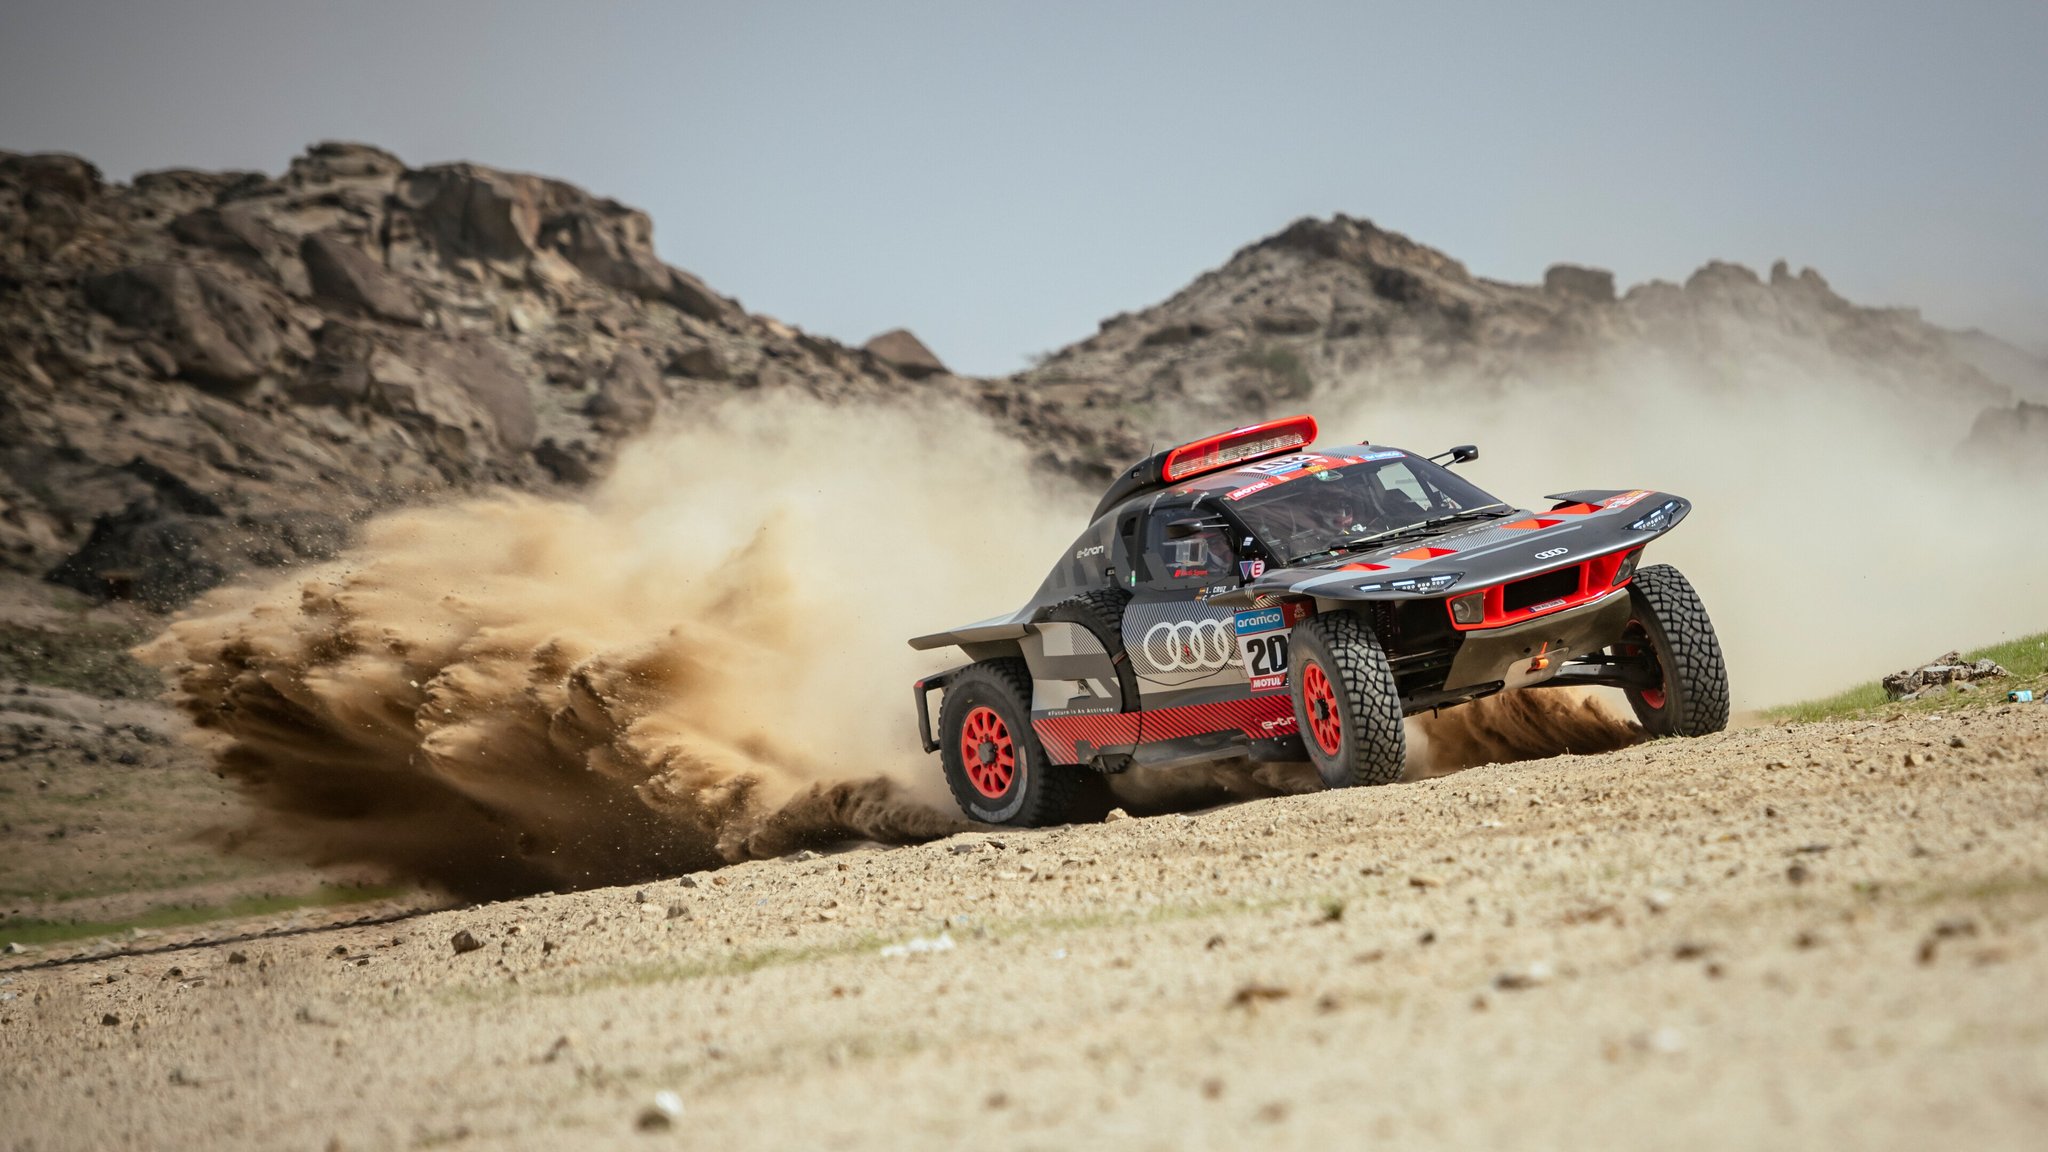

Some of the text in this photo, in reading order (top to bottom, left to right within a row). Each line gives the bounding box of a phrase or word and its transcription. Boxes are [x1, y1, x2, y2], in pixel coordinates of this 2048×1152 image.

[1233, 482, 1269, 498] MOTUL
[1077, 545, 1104, 559] e-tron
[1213, 585, 1227, 593] CRUZ
[1237, 613, 1281, 628] aramco
[1246, 633, 1290, 676] 20
[1253, 676, 1281, 688] MOTUL
[1261, 716, 1296, 730] e-tr
